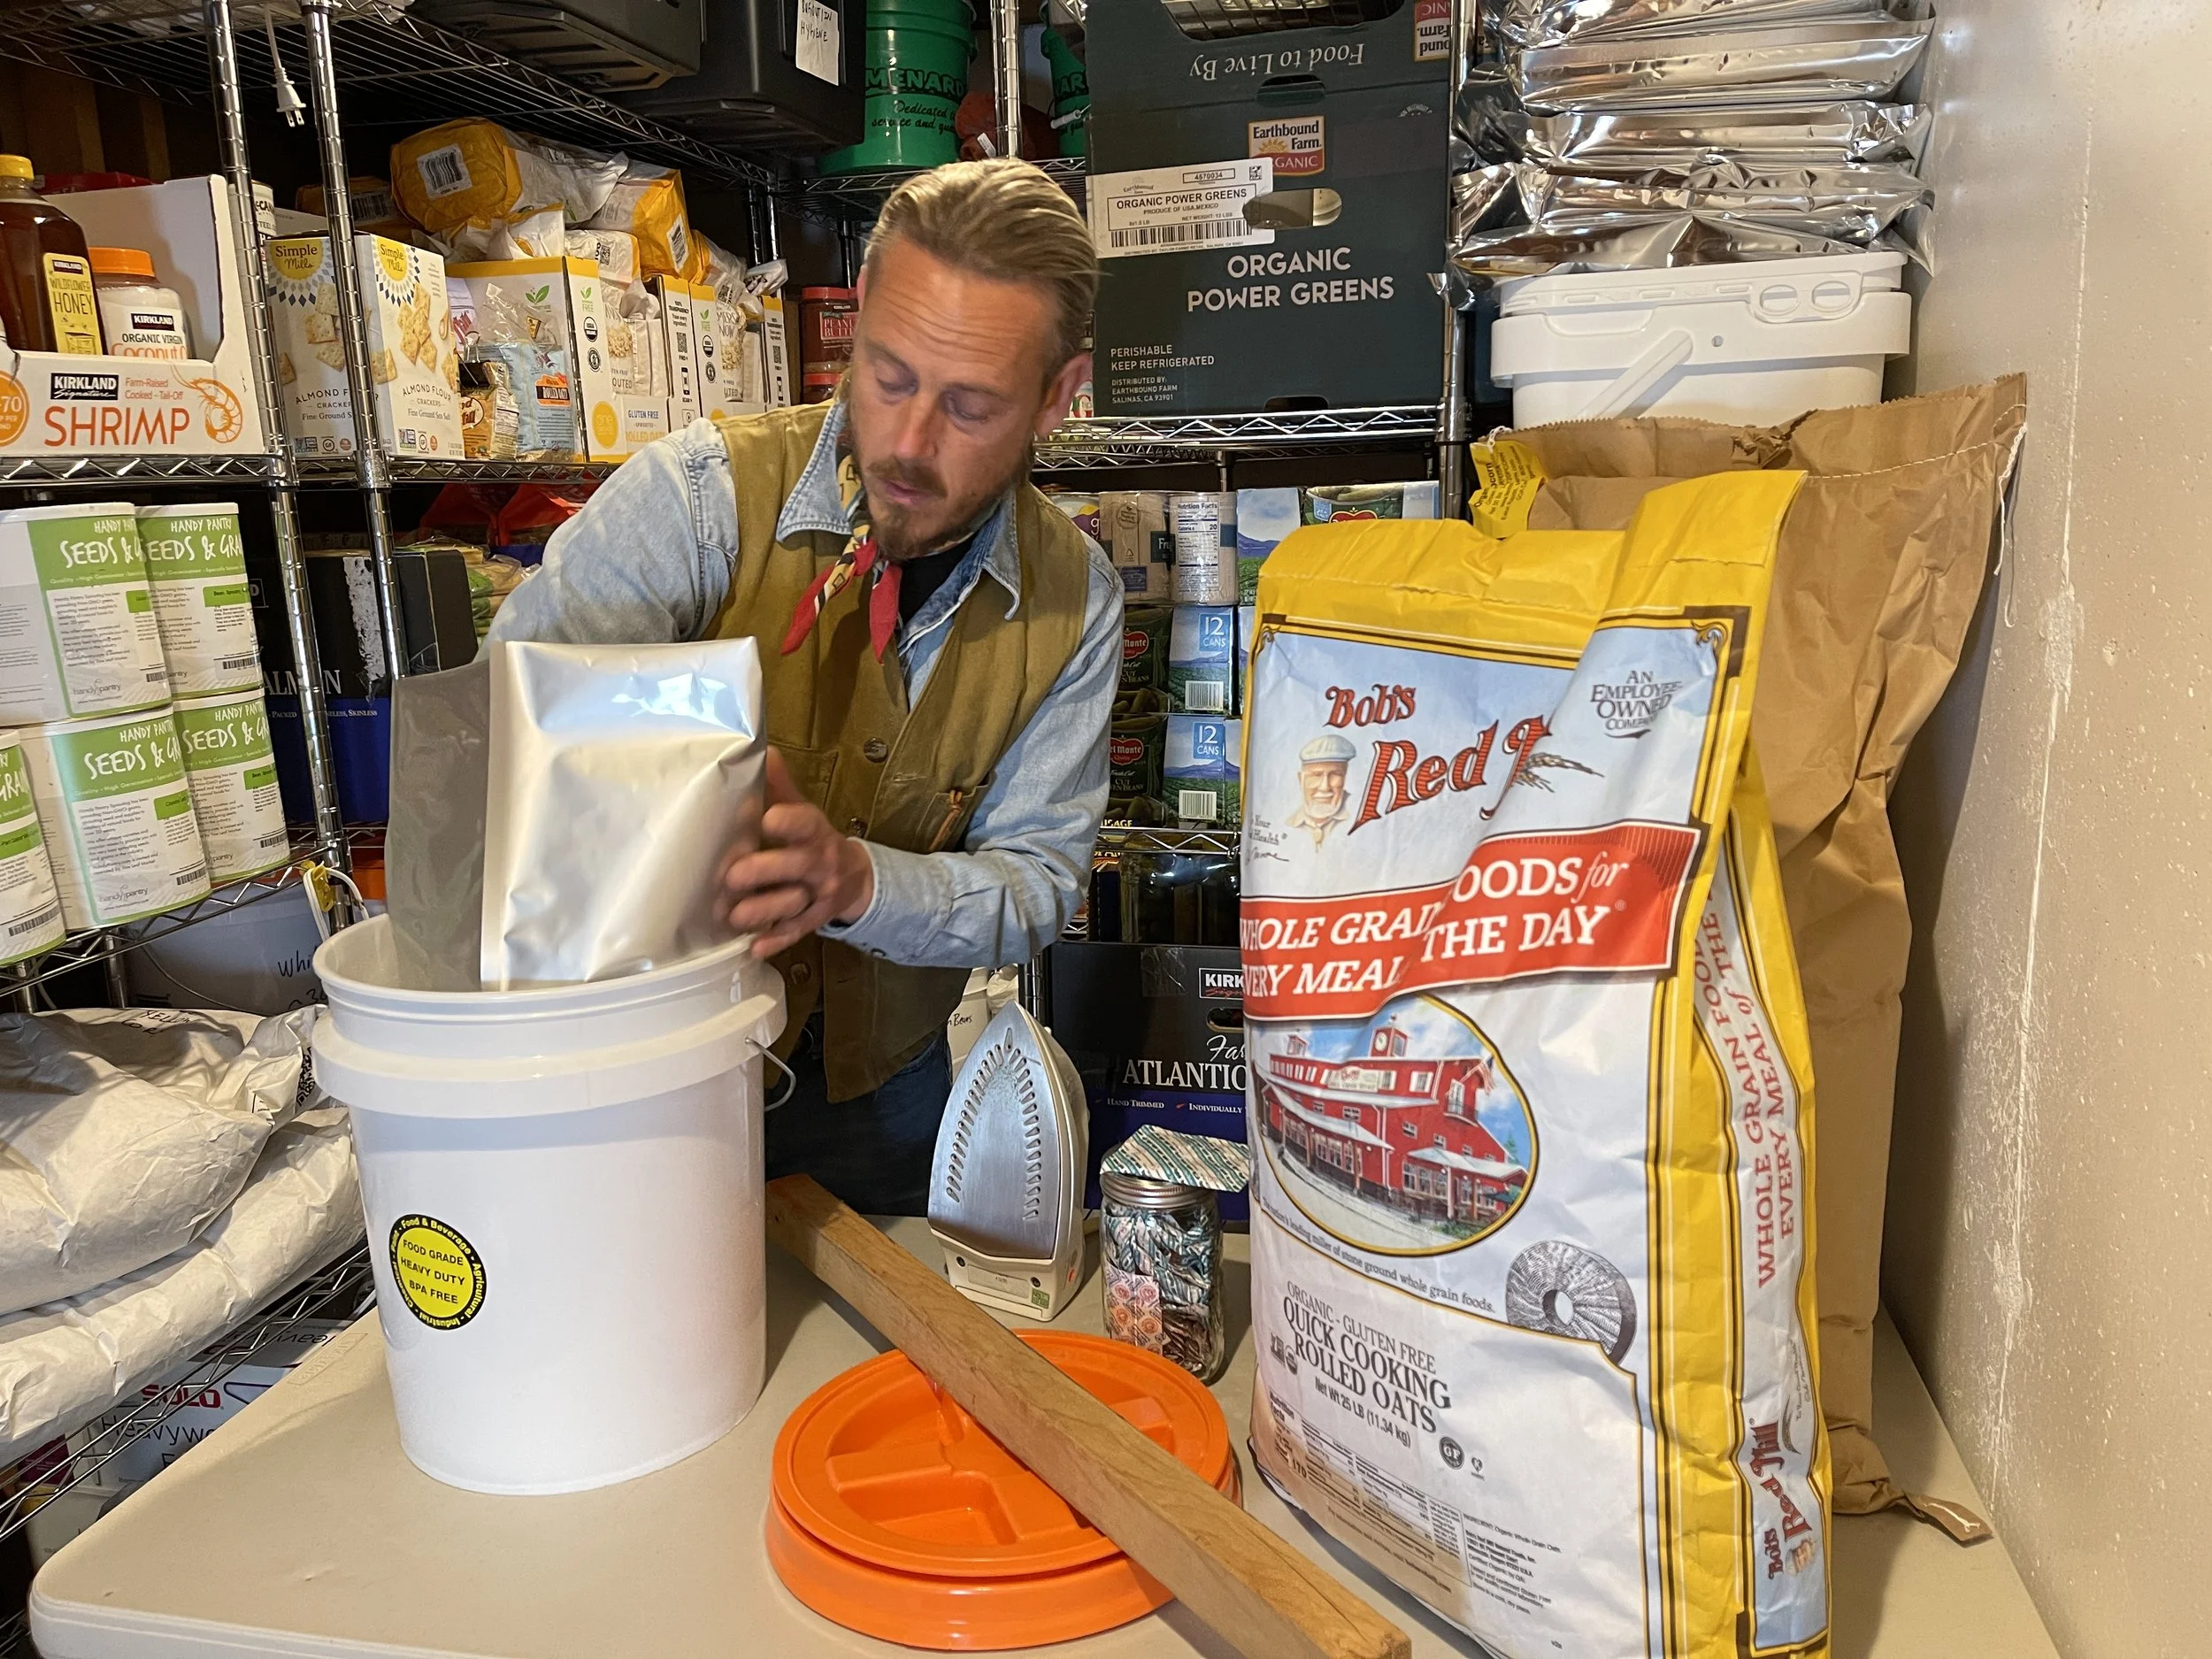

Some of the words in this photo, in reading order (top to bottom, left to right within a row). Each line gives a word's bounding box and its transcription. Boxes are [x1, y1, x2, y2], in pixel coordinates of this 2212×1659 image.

[1225, 54, 1273, 76] Live
[1280, 50, 1301, 67] to
[1310, 43, 1365, 71] Food
[1190, 55, 1217, 81] By
[865, 68, 964, 95] MENARD
[895, 100, 947, 118] Dedicated
[916, 119, 934, 129] and
[1253, 120, 1319, 139] Earthbound
[1274, 156, 1318, 168] GANIC
[1117, 196, 1163, 209] ORGANIC
[1165, 193, 1202, 204] POWER
[1205, 188, 1247, 201] GREENS
[276, 244, 318, 257] Simple
[380, 244, 404, 261] Simple
[284, 257, 313, 270] Mills
[1227, 247, 1351, 279] ORGANIC
[54, 292, 93, 315] HONEY
[1187, 286, 1281, 312] POWER
[1290, 276, 1395, 304] GREENS
[134, 315, 173, 326] KIRKLAND
[121, 334, 161, 344] ORGANIC
[1111, 345, 1172, 357] PERISHABLE
[1111, 360, 1137, 371] KEEP
[1140, 356, 1215, 369] REFRIGERATED
[54, 376, 117, 390] KIRKLAND
[125, 378, 169, 388] Farm-Raised
[1111, 377, 1155, 386] DISTRIBUTED
[1112, 386, 1157, 395] EARTHBOUND
[54, 388, 117, 399] Signature
[125, 390, 152, 399] Cooked
[159, 391, 184, 400] Tail-Off
[296, 388, 339, 404] ALMOND
[403, 383, 431, 396] ALMOND
[432, 386, 451, 403] FLOUR
[417, 398, 442, 407] CRACKERS
[1112, 396, 1143, 404] SALINAS,
[628, 410, 646, 419] GLUTEN
[647, 411, 659, 419] FREE
[44, 406, 190, 447] SHRIMP
[94, 519, 121, 533] HANDY
[171, 519, 204, 533] HANDY
[207, 518, 232, 531] PANTRY
[60, 537, 118, 568] SEEDS
[120, 537, 134, 564] &
[146, 535, 196, 561] EEDS
[202, 535, 216, 561] &
[1205, 617, 1225, 636] 12
[1203, 636, 1226, 648] CANS
[264, 670, 342, 695] ALMN
[1626, 671, 1654, 684] AN
[215, 706, 243, 722] HANDY
[1324, 684, 1416, 728] Bob's
[1596, 694, 1672, 718] OWNED
[119, 725, 151, 742] HANDY
[181, 723, 237, 754] SEEDS
[242, 721, 254, 745] &
[1199, 726, 1218, 744] 12
[84, 744, 146, 780] SEEDS
[150, 741, 165, 768] &
[1197, 746, 1219, 756] CANS
[1348, 720, 1498, 835] Red
[1452, 857, 1584, 901] OODS
[1577, 851, 1629, 904] for
[125, 887, 149, 899] pantry
[1242, 964, 1293, 998] VERY
[1422, 921, 1507, 962] THE
[1518, 905, 1612, 952] DAY
[1700, 912, 1735, 982] THE
[1206, 973, 1243, 987] KIRK
[1724, 987, 1755, 1016] of
[1746, 1020, 1785, 1122] MEAL
[1724, 1036, 1764, 1145] GRAIN
[1130, 1100, 1164, 1109] TRIMMED
[1189, 1103, 1242, 1113] INDIVIDUALLY
[1770, 1129, 1794, 1240] EVERY
[1754, 1152, 1777, 1289] WHOLE
[430, 1220, 472, 1256] Beverage
[403, 1239, 426, 1256] FOOD
[429, 1249, 464, 1266] GRADE
[401, 1256, 431, 1277] HEAVY
[434, 1271, 465, 1286] DUTY
[1312, 1234, 1332, 1251] miller
[1333, 1246, 1340, 1256] of
[1341, 1250, 1363, 1266] stone
[1364, 1263, 1397, 1283] ground
[1399, 1273, 1427, 1294] whole
[1429, 1286, 1459, 1303] grain
[1462, 1293, 1495, 1314] foods.
[409, 1279, 427, 1295] BPA
[430, 1288, 458, 1304] FREE
[468, 1263, 485, 1318] Agricultural
[419, 1311, 461, 1328] Industrial
[1287, 1280, 1333, 1324] ORGANIC
[1343, 1315, 1396, 1355] GLUTEN
[1400, 1341, 1437, 1374] FREE
[1284, 1296, 1336, 1352] QUICK
[1340, 1333, 1452, 1409] COOKING
[1294, 1332, 1365, 1396] ROLLED
[1372, 1380, 1437, 1433] OATS
[141, 1384, 222, 1409] SOLO
[1315, 1376, 1328, 1395] Net
[1328, 1386, 1341, 1406] Wt
[1341, 1394, 1352, 1411] 25
[1354, 1402, 1365, 1419] LB
[1366, 1408, 1394, 1436] (11.34
[1395, 1424, 1412, 1449] kg)
[1749, 1419, 1785, 1479] Mill
[1292, 1458, 1307, 1478] 170
[1761, 1472, 1813, 1543] Red
[1764, 1527, 1784, 1580] Bob's
